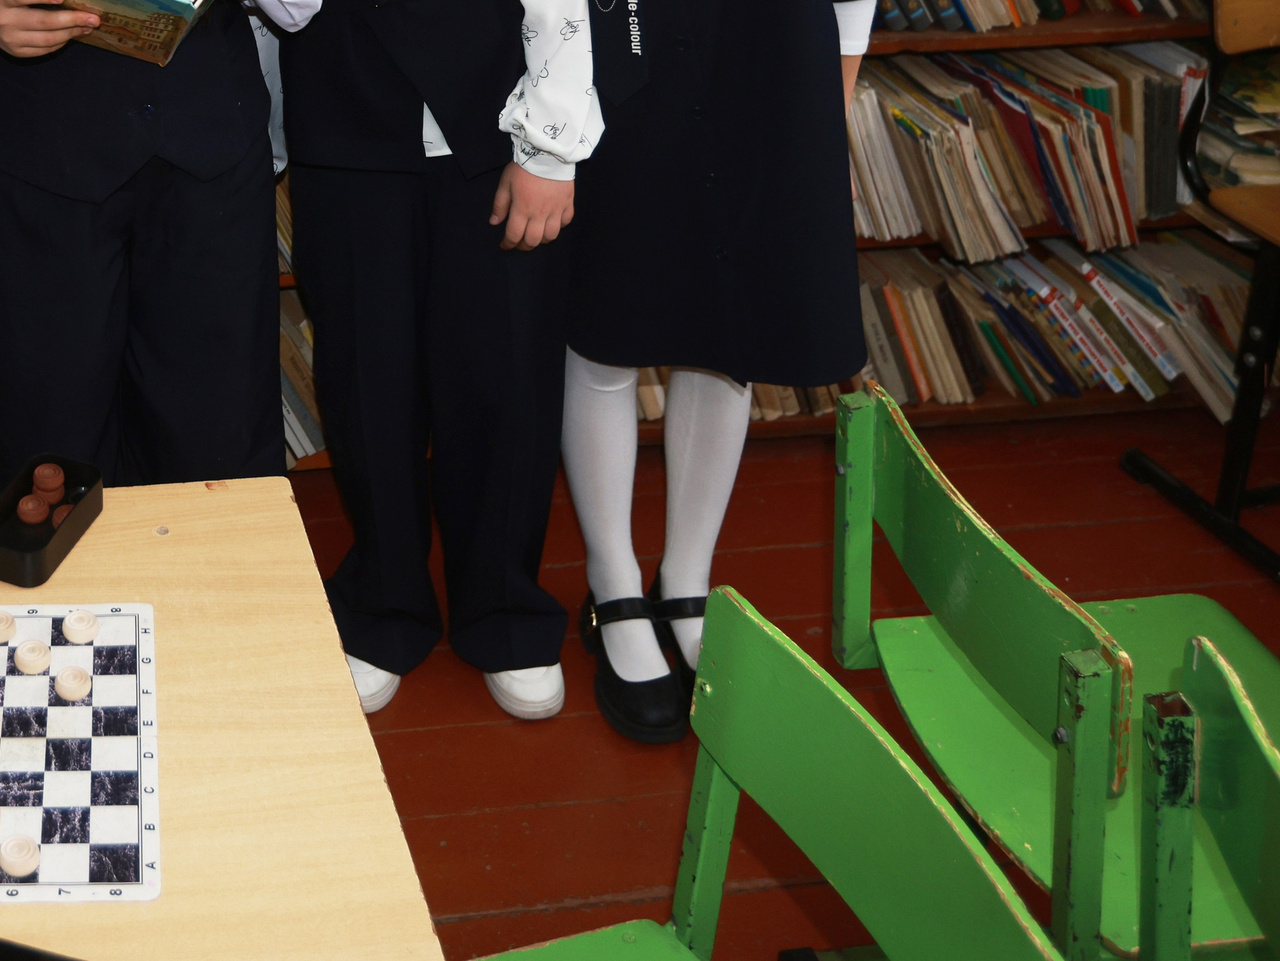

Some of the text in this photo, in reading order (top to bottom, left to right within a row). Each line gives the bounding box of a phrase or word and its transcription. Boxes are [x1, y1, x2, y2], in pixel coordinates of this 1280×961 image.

[141, 657, 152, 665] G
[143, 751, 154, 759] D
[144, 823, 155, 831] B
[145, 861, 156, 870] A
[6, 889, 19, 897] 6
[58, 888, 72, 896] 7
[109, 888, 122, 897] 8
